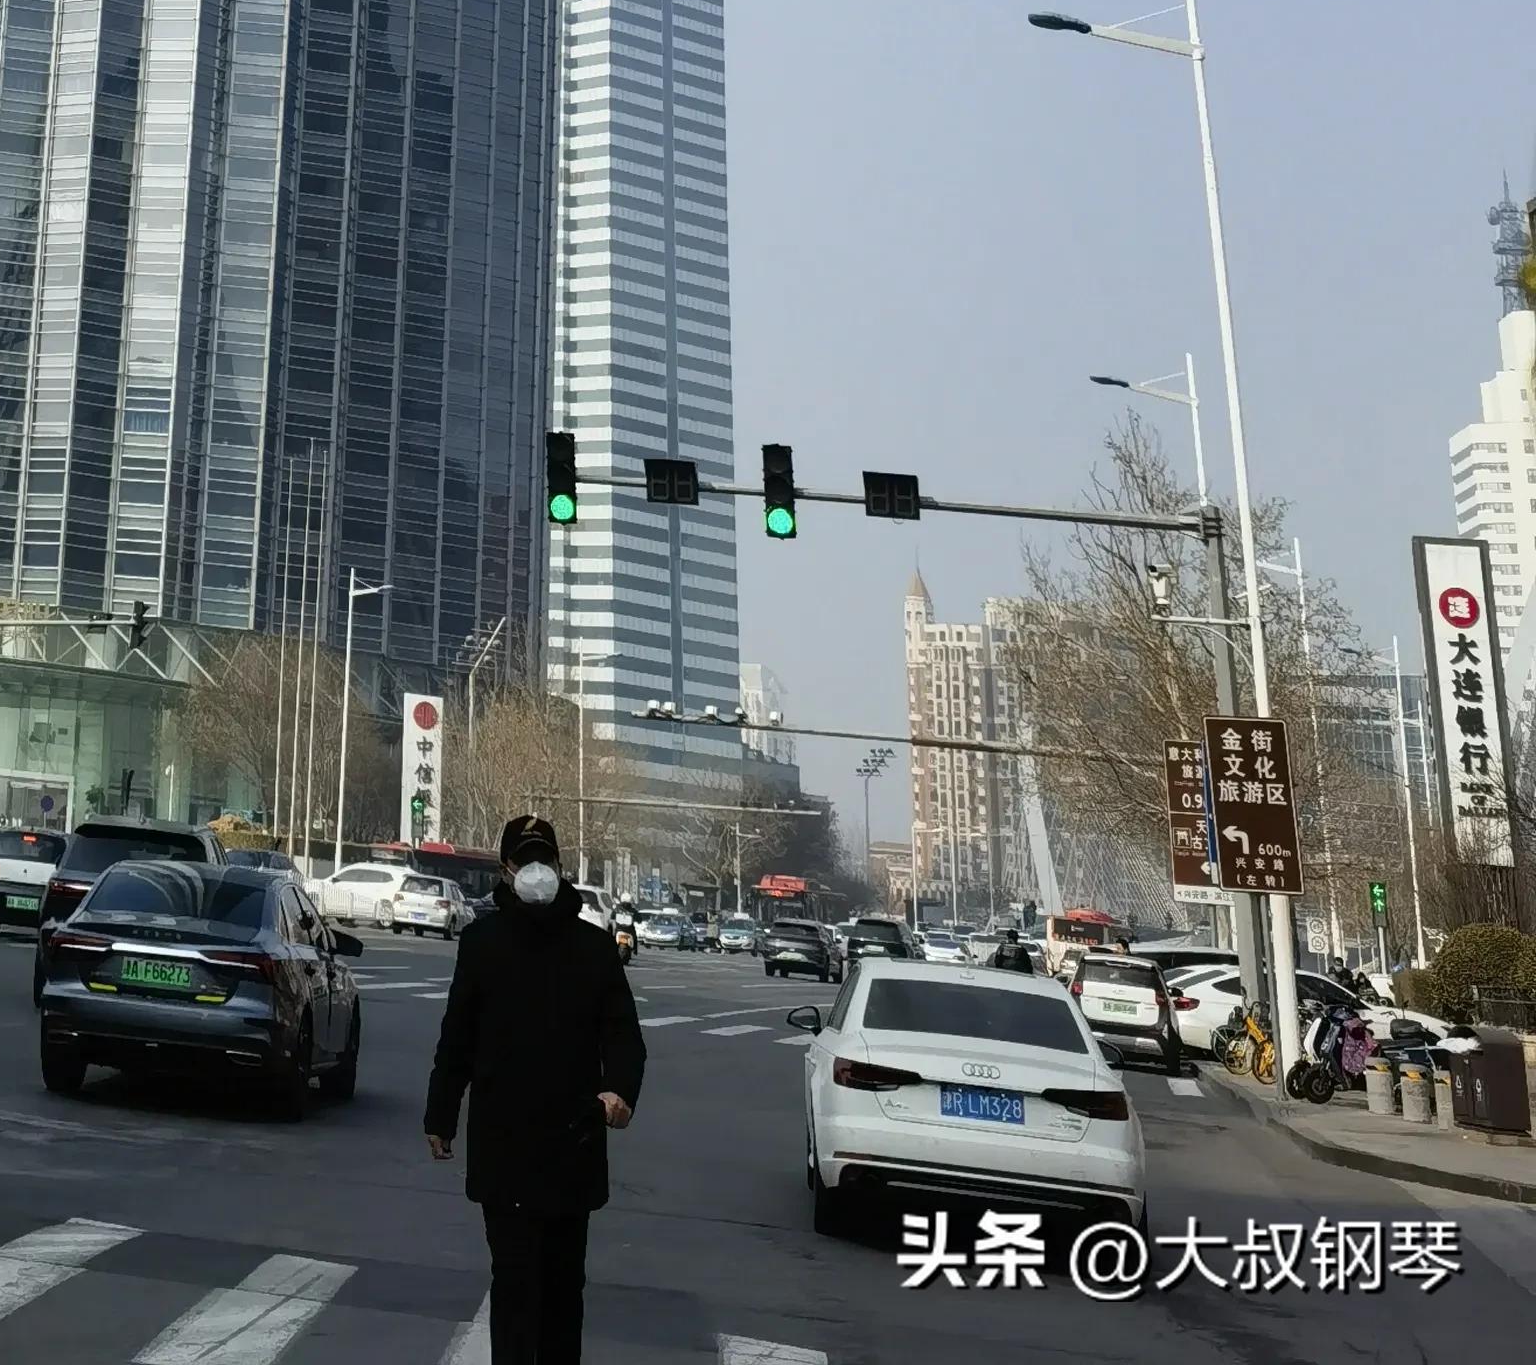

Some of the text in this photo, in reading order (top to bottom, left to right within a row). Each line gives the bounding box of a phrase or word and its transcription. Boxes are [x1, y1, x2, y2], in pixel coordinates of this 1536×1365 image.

[1448, 633, 1491, 775] 大连银行
[1220, 728, 1272, 752] 金街
[1223, 754, 1277, 779] 文化
[1218, 779, 1288, 806] 旅游区
[1258, 843, 1292, 858] 600m
